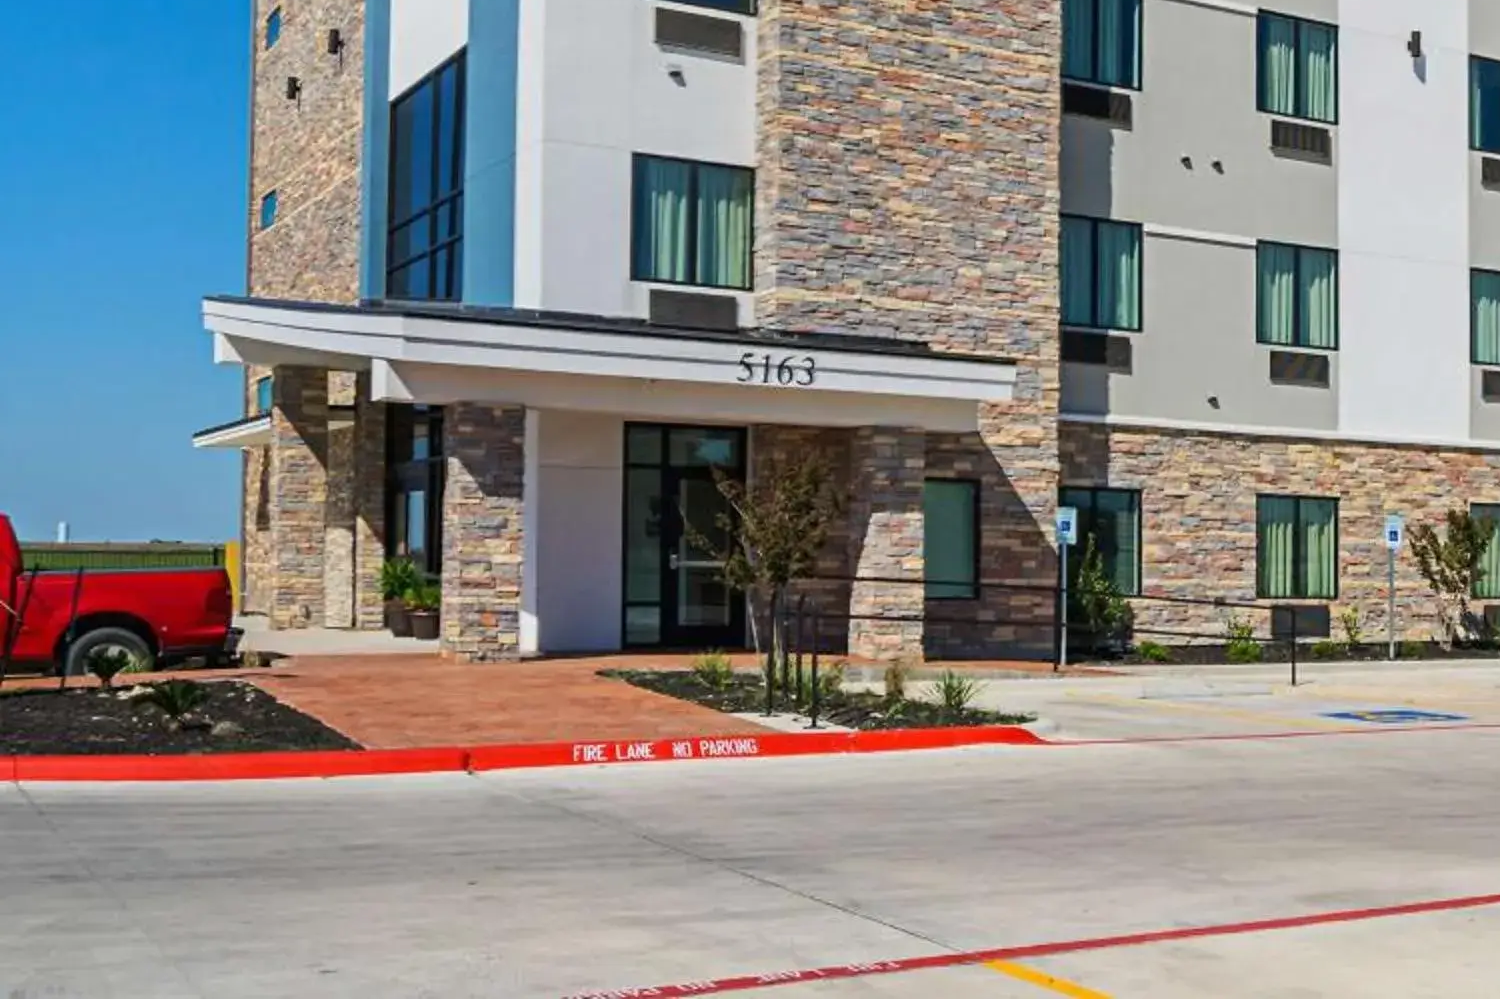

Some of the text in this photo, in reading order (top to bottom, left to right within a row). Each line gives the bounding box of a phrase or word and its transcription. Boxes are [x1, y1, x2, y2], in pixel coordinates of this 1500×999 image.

[736, 352, 816, 386] 5163
[572, 738, 759, 762] FIRE LANE NO PARKING
